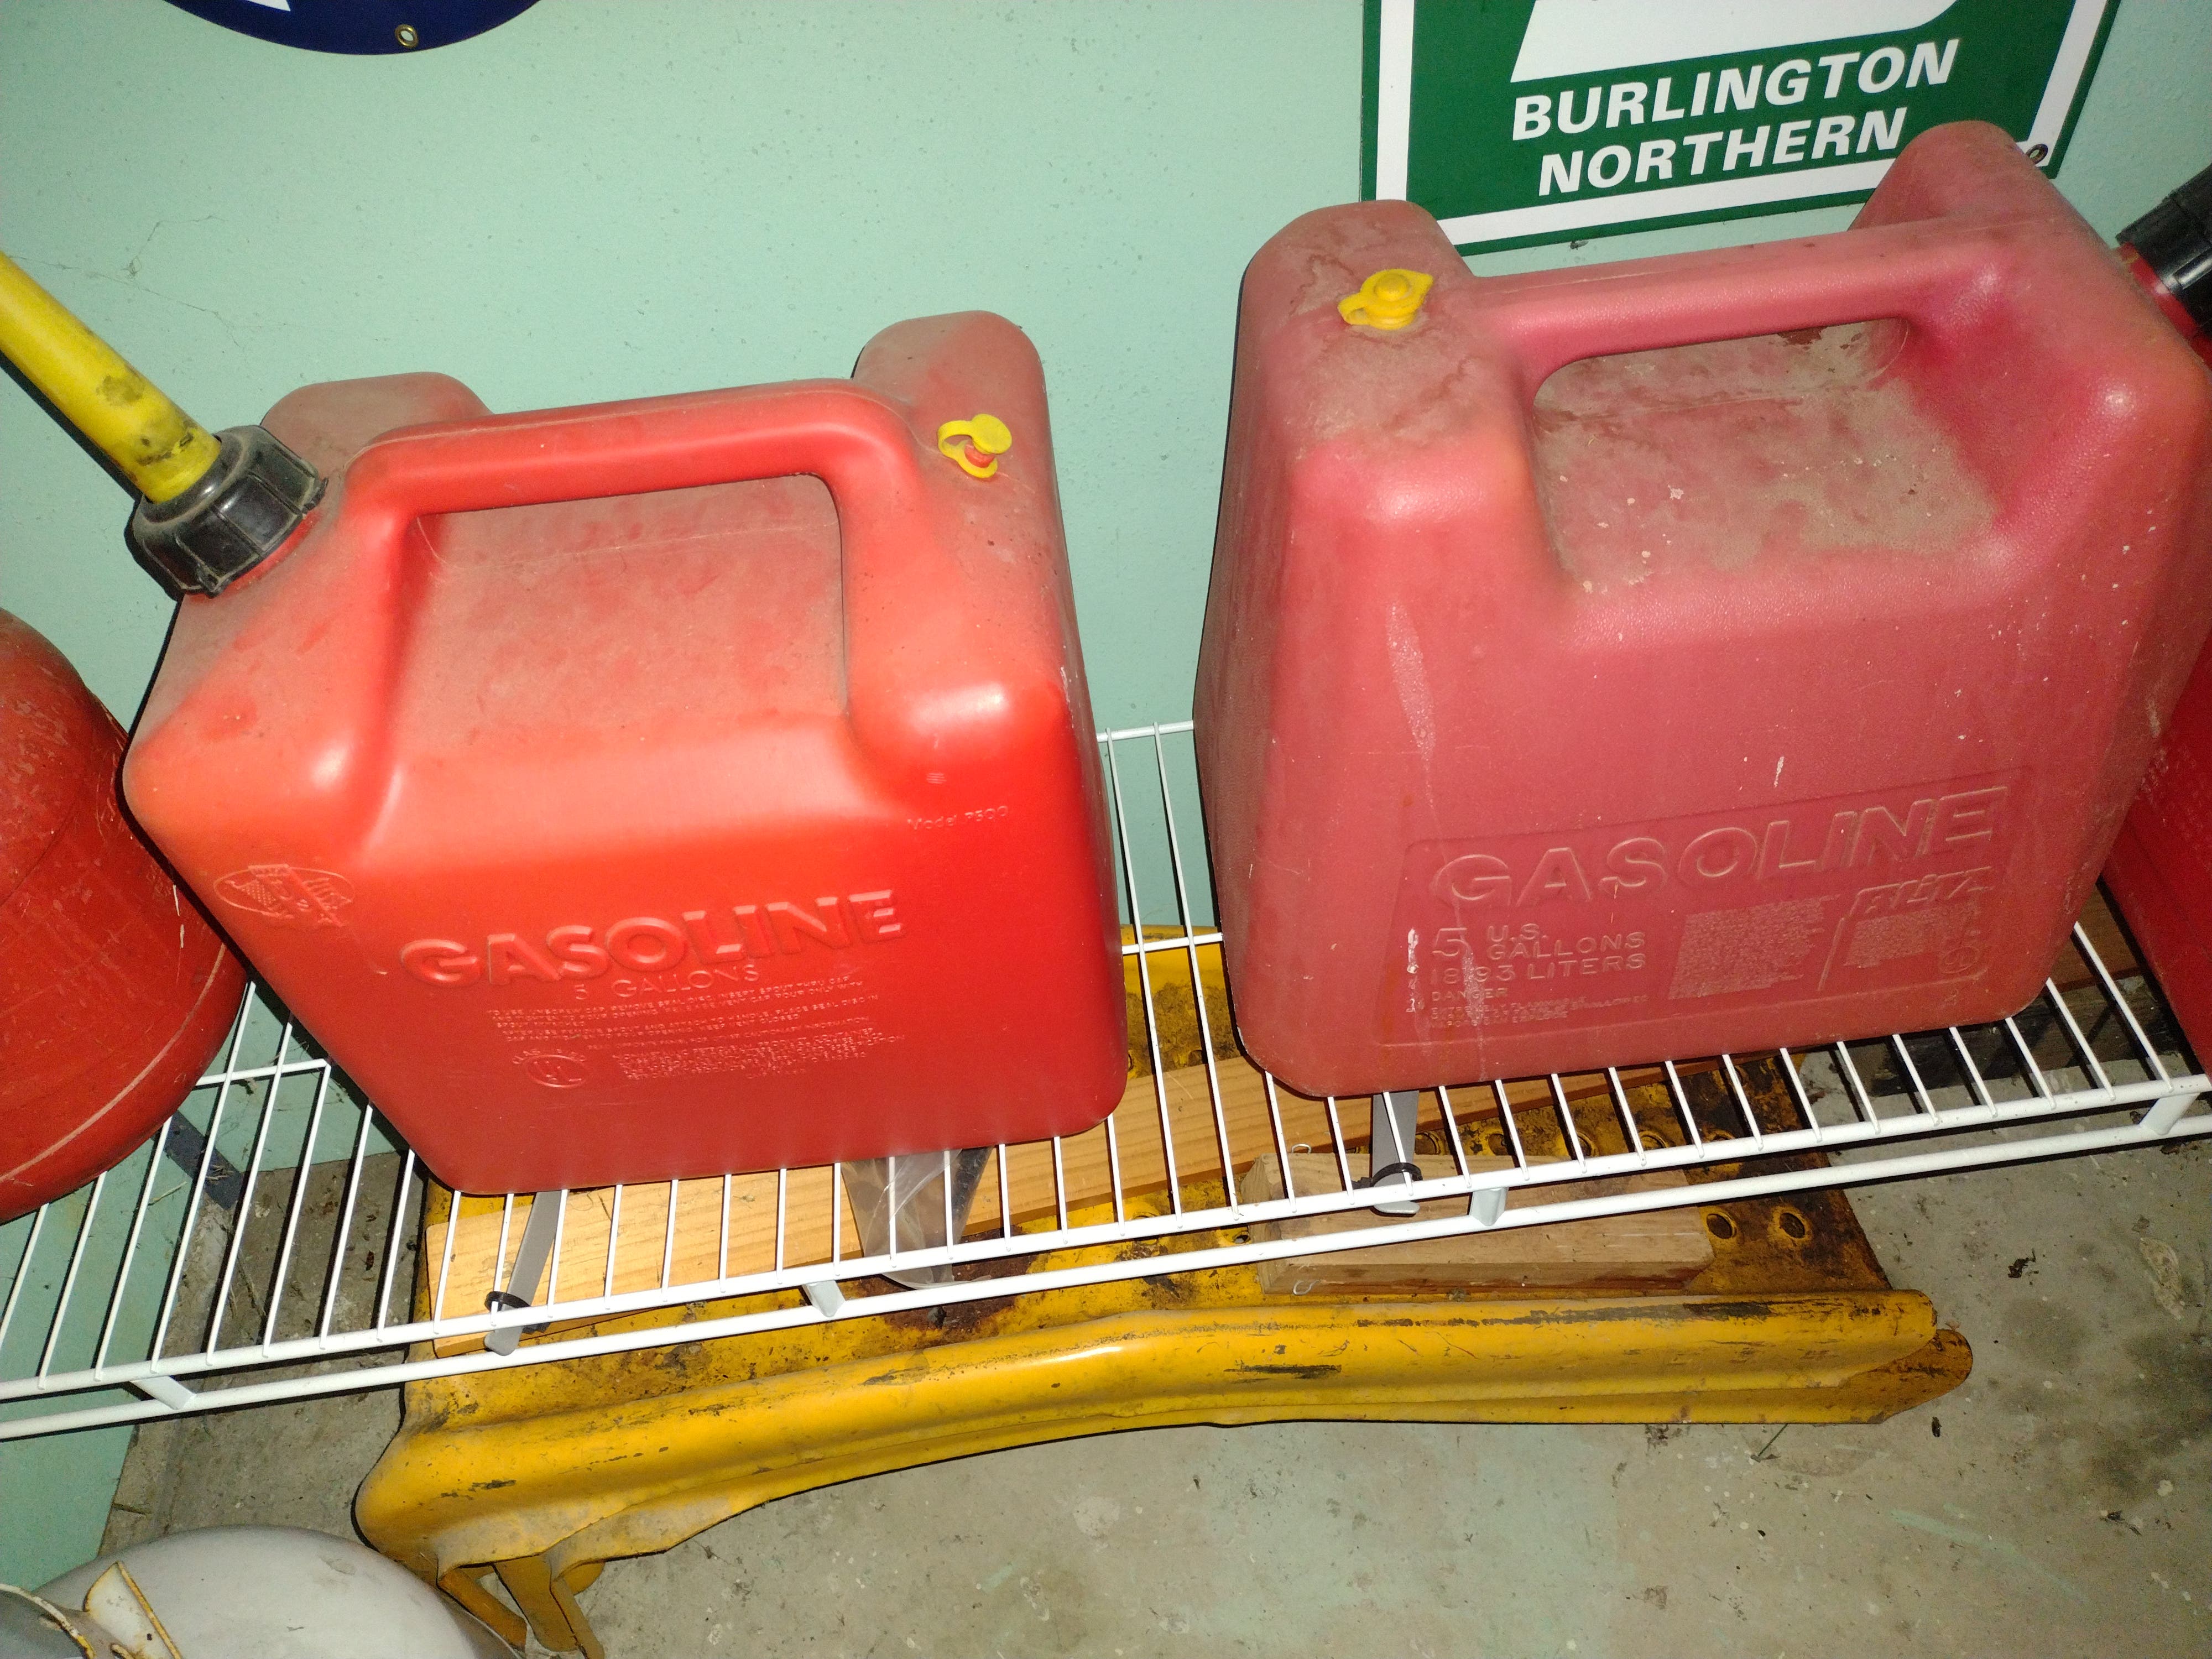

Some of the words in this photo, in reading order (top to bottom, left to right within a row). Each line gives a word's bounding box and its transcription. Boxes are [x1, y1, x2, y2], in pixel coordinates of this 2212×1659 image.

[1512, 38, 1960, 140] BURLINGTON
[1538, 108, 1907, 196] NORTHERN
[1433, 786, 2008, 907] GASOLINE
[400, 889, 906, 988] GASOLINE
[1432, 927, 1472, 957] 5
[1486, 931, 1646, 961] GALLONS
[1487, 923, 1550, 943] U.S.
[611, 964, 760, 998] GALLONS
[1430, 963, 1516, 985] 1893
[1527, 953, 1646, 980] LITERS
